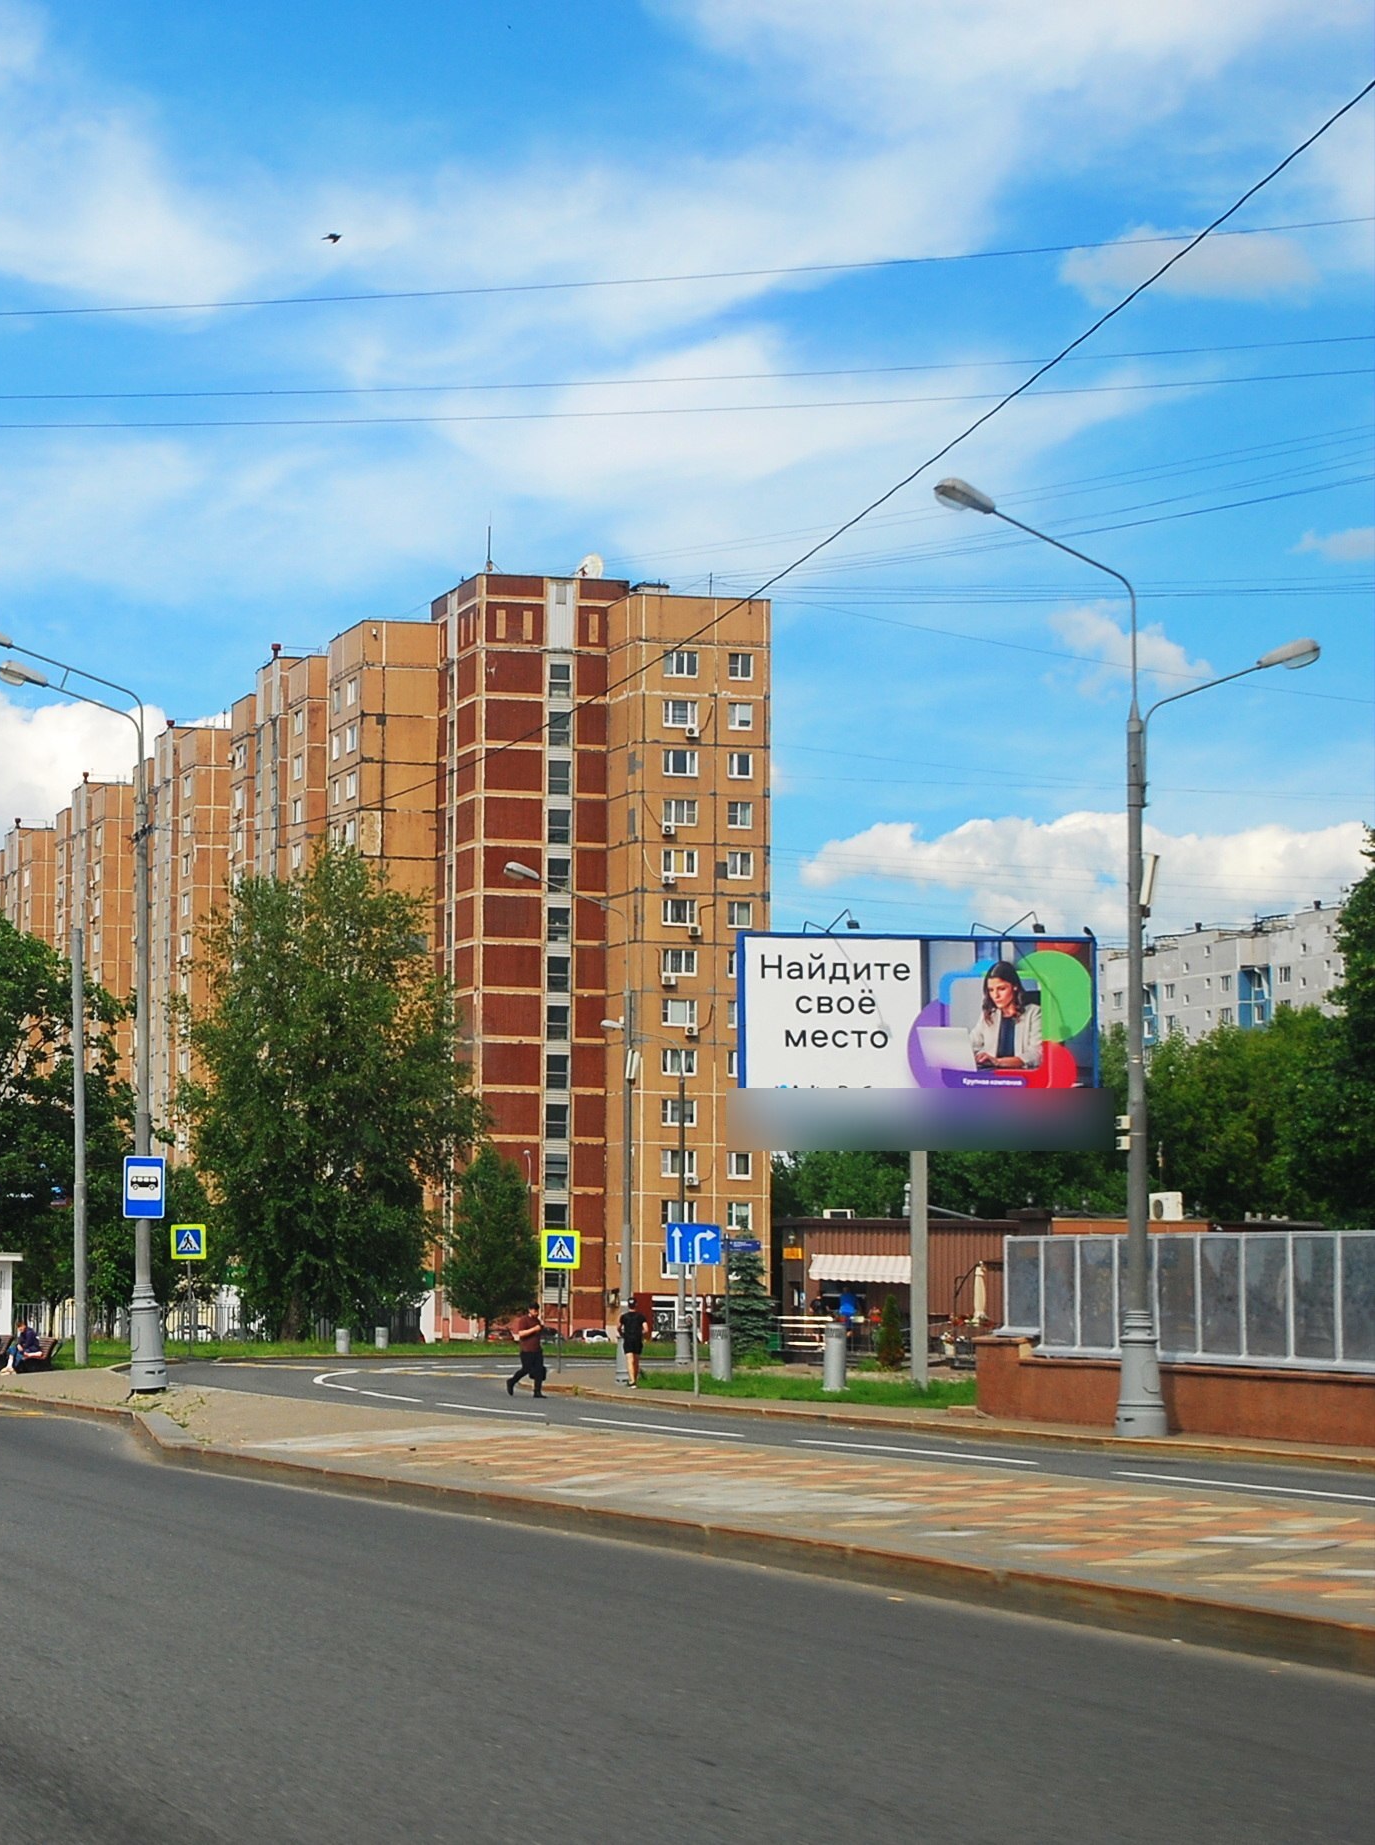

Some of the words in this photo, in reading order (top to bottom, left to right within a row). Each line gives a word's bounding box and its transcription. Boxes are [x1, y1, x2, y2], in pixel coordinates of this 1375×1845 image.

[759, 953, 911, 985] Найдите
[795, 987, 877, 1015] своё
[783, 1027, 890, 1049] место
